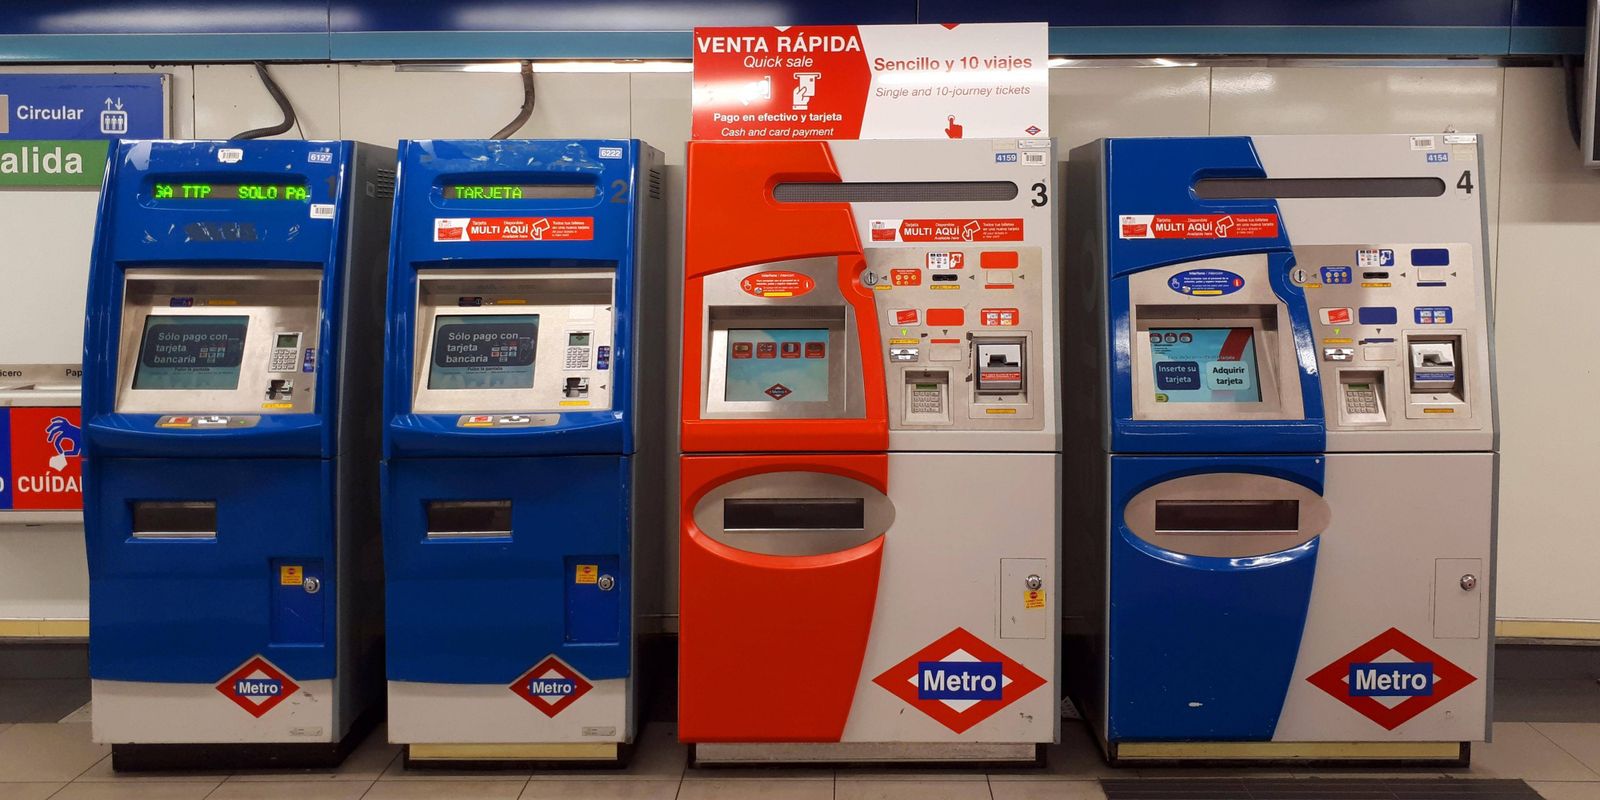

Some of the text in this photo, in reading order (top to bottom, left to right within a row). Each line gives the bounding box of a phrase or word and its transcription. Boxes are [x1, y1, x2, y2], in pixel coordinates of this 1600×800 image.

[697, 32, 860, 53] VENTA RÁPIDA
[743, 55, 813, 68] Quick sale
[874, 55, 1032, 72] Sencillo y 10 viajes
[875, 85, 1031, 99] Single and 10-journey tickets
[17, 105, 84, 120] Circular
[713, 113, 740, 123] Pago
[758, 113, 798, 121] efectivo
[800, 114, 807, 123] y
[809, 113, 842, 122] tarjeta
[721, 128, 834, 139] Cash and card payment
[1457, 170, 1473, 194] 4
[182, 185, 211, 199] TTP
[238, 186, 278, 199] SOLO
[455, 186, 524, 199] TARJETA
[611, 179, 628, 203] 2
[1031, 183, 1048, 207] 3
[471, 224, 528, 234] MULTI AQUÍ
[904, 225, 960, 235] MULTI AQUÍ
[1156, 221, 1212, 231] MULTI AQUÍ
[158, 332, 180, 341] Sólo
[183, 334, 207, 342] pago
[448, 332, 471, 340] Sólo
[472, 333, 498, 342] pago
[156, 344, 187, 353] tarjeta
[447, 344, 478, 353] tarjeta
[154, 355, 196, 363] bancaria
[446, 355, 488, 363] bancaria
[1213, 367, 1245, 375] Adquirir
[1165, 376, 1192, 385] tarjeta
[1216, 377, 1243, 386] tarjeta
[18, 471, 83, 493] CUÍDA
[924, 670, 997, 692] Metro
[1356, 669, 1427, 690] Metro
[239, 682, 278, 694] Metro
[532, 681, 572, 694] Metro
